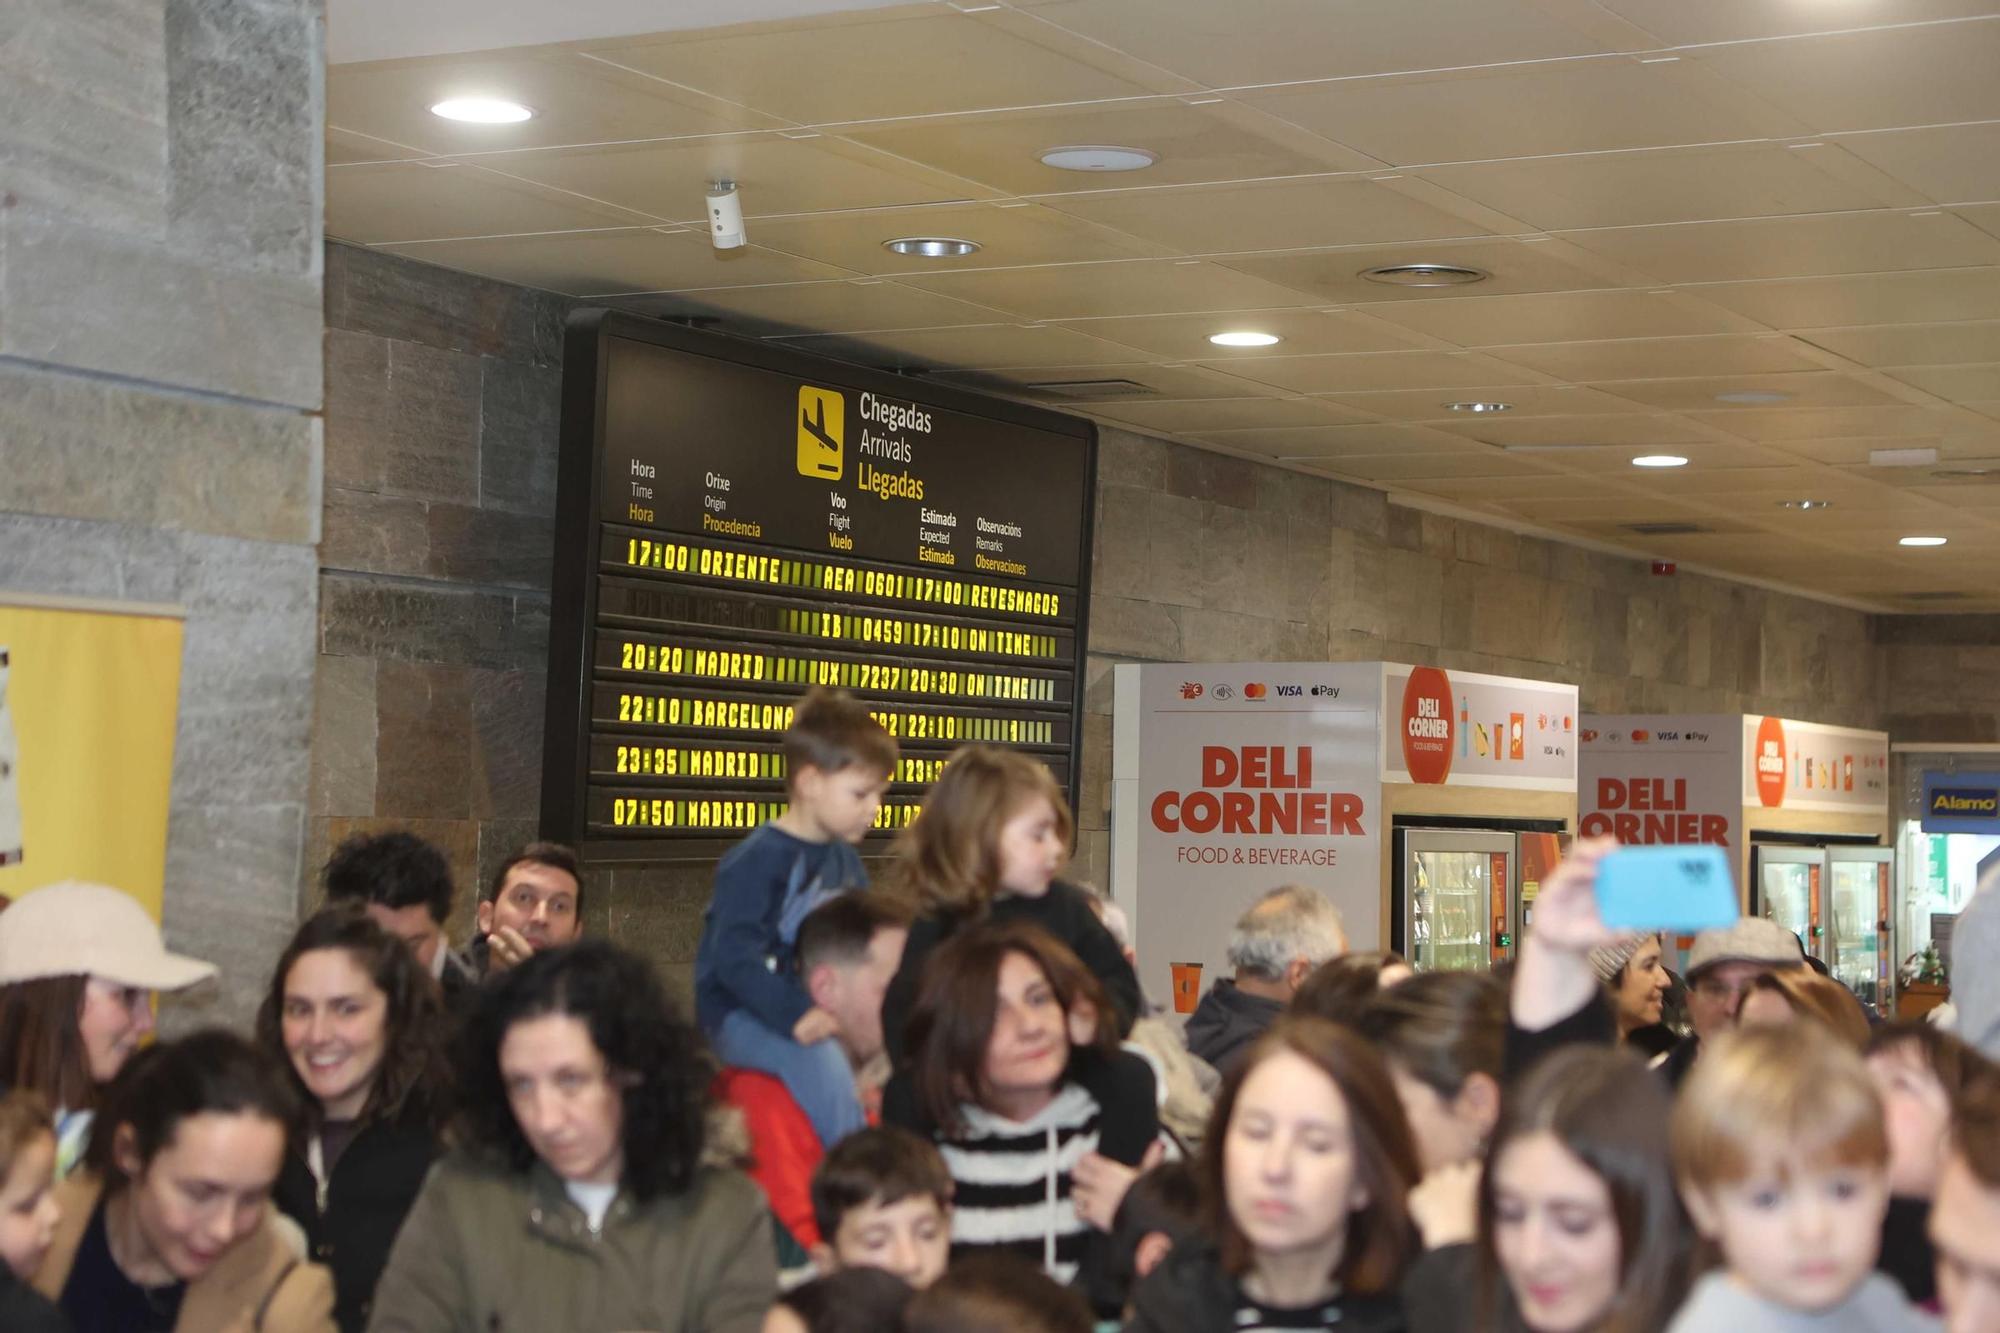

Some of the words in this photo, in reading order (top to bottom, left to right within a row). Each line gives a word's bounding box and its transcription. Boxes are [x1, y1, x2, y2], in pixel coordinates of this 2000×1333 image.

[859, 391, 932, 434] Chegadas
[859, 428, 912, 463] Arrivals
[630, 458, 656, 479] Hora
[631, 481, 653, 500] Time
[705, 471, 731, 492] Orixe
[858, 461, 924, 500] Llegadas
[704, 494, 727, 512] Origin
[830, 491, 847, 509] Voo
[629, 503, 654, 523] Hora
[829, 513, 851, 531] Flight
[920, 507, 957, 528] Estimada
[703, 513, 761, 538] Procedencia
[919, 527, 951, 545] Expected
[976, 516, 1022, 538] Observacións
[829, 532, 853, 551] Vuelo
[975, 536, 1004, 553] Remarks
[919, 546, 955, 566] Estimada
[975, 553, 1027, 576] Observaciones
[628, 539, 688, 571] 17:00
[700, 549, 780, 583] ORIENTE
[823, 566, 854, 592] AEA
[865, 571, 902, 598] 0601
[915, 577, 962, 605] 17:00
[971, 585, 1059, 616] REYESMAGOS
[822, 613, 841, 638] IB
[863, 618, 902, 644] 0459
[914, 623, 959, 650] 17:10
[969, 629, 987, 651] ON
[997, 631, 1031, 656] TIME
[622, 643, 682, 673] 20:20
[695, 650, 764, 680] MADRID
[819, 661, 839, 686] UX
[860, 664, 900, 690] 7237
[910, 669, 957, 694] 20:30
[967, 673, 985, 696] ON
[995, 676, 1029, 700] TIME
[1276, 685, 1303, 696] VISA
[1320, 685, 1340, 698] Pay
[619, 695, 680, 724] 22:10
[693, 700, 794, 730] BARCELONA
[908, 714, 955, 739] 22:10
[1418, 698, 1439, 717] DELI
[1408, 718, 1449, 739] CORNER
[1658, 732, 1678, 741] VISA
[617, 746, 677, 775] 23:35
[690, 750, 758, 778] MADRID
[1202, 746, 1312, 788] DELI
[1597, 778, 1686, 811] DELI
[1934, 795, 1996, 811] Alamo
[614, 799, 674, 826] 07:50
[688, 801, 756, 827] MADRID
[1151, 791, 1366, 835] CORNER
[1579, 813, 1729, 846] ORNER
[1177, 847, 1228, 864] FOOD
[1232, 848, 1244, 864] &
[1248, 849, 1336, 866] BEVERAGE
